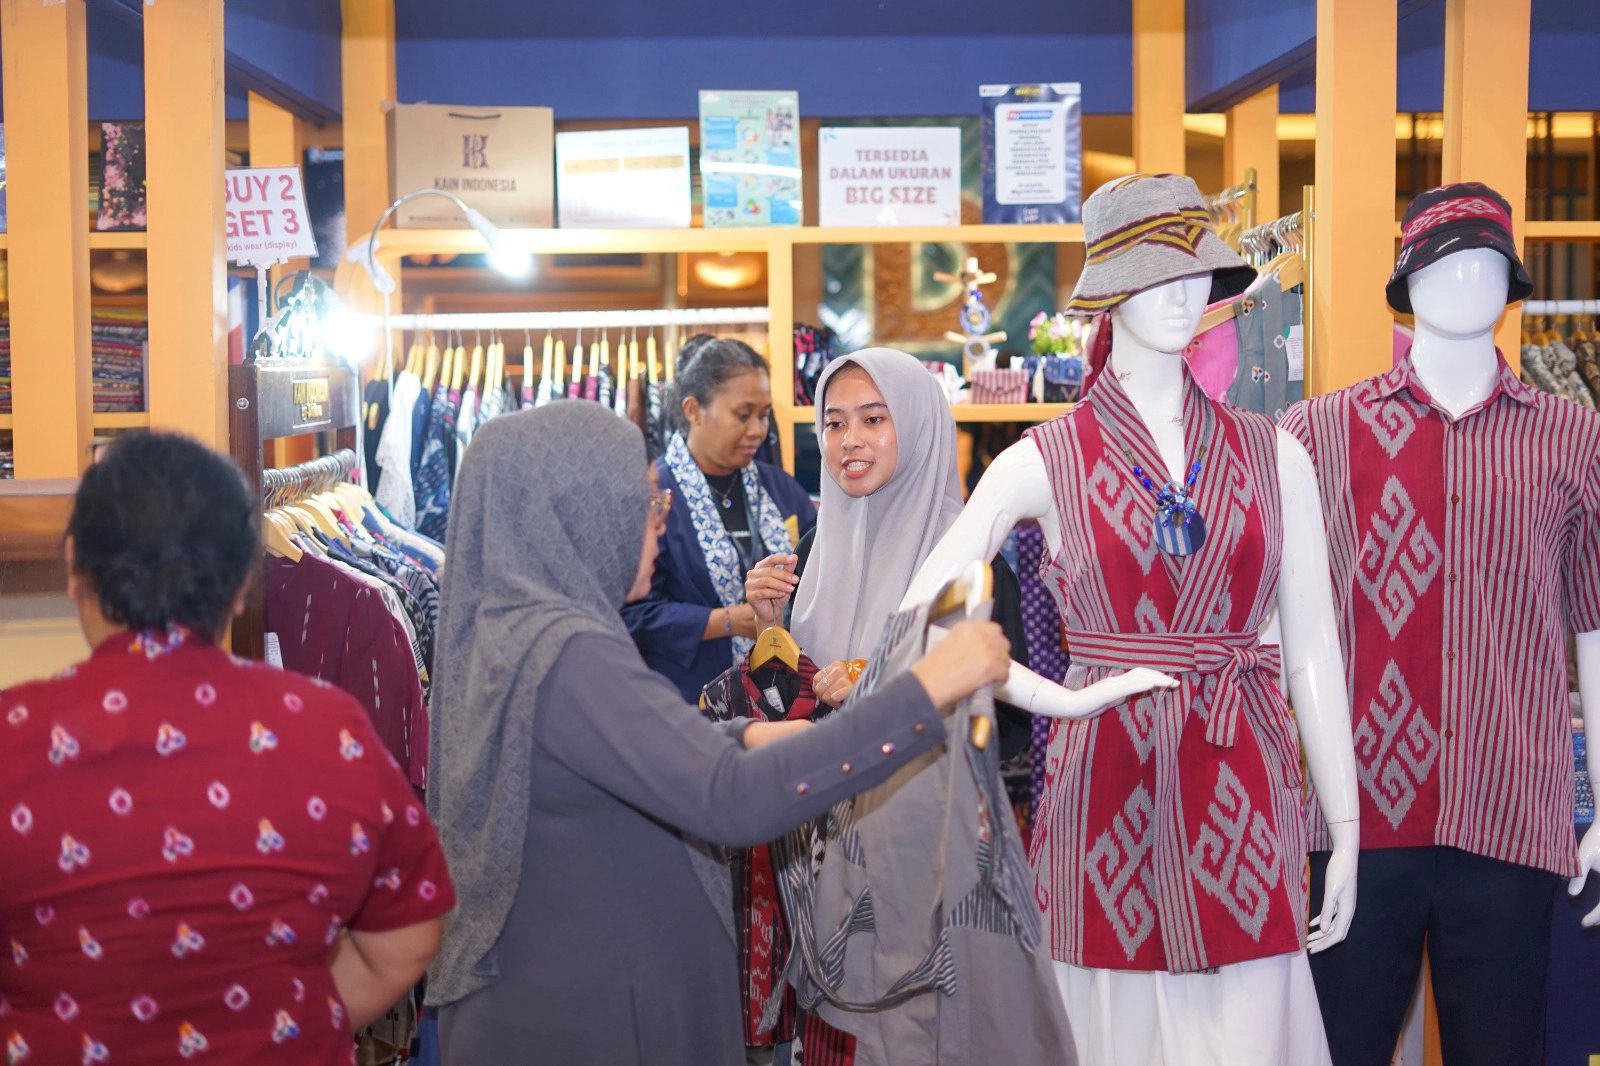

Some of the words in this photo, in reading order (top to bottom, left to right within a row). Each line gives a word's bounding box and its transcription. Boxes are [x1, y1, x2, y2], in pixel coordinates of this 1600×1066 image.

[856, 150, 929, 162] TERSEDIA
[829, 167, 884, 180] DALAM
[888, 167, 952, 180] UKURAN
[278, 174, 296, 201] 2
[434, 177, 460, 191] KAIN
[461, 177, 517, 192] INDONESIA
[845, 186, 884, 205] BIG
[889, 186, 937, 205] SIZE
[281, 208, 299, 235] 3
[227, 243, 242, 252] kids
[244, 242, 262, 250] wear
[264, 240, 297, 251] (display)
